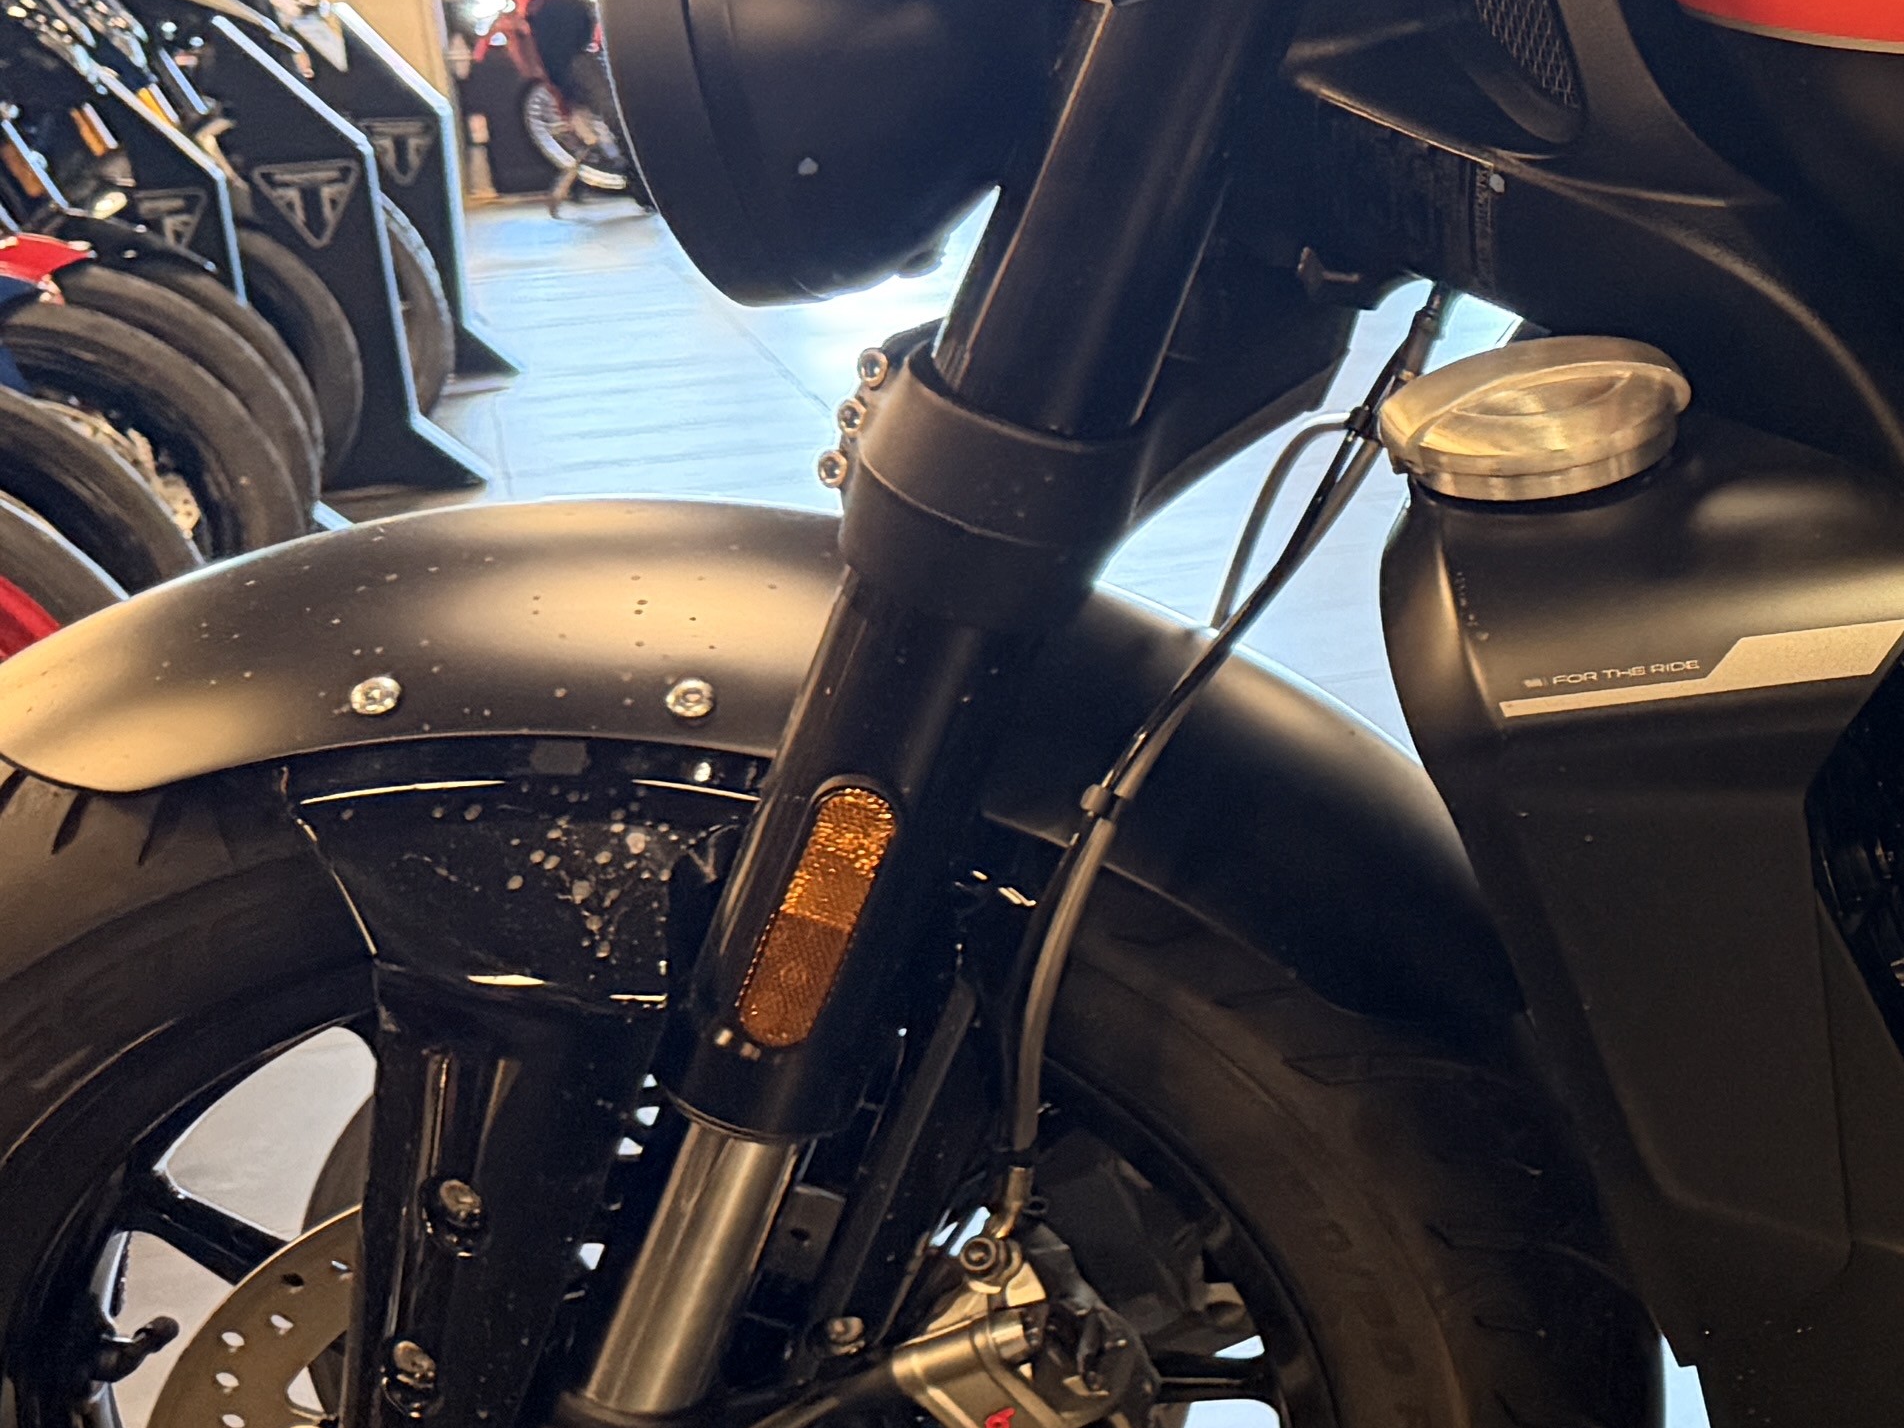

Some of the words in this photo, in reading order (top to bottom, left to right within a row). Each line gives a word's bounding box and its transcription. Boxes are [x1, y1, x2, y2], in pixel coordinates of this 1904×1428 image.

[1552, 671, 1598, 685] FOR
[1602, 665, 1646, 679] THE
[1650, 659, 1701, 674] RIDE
